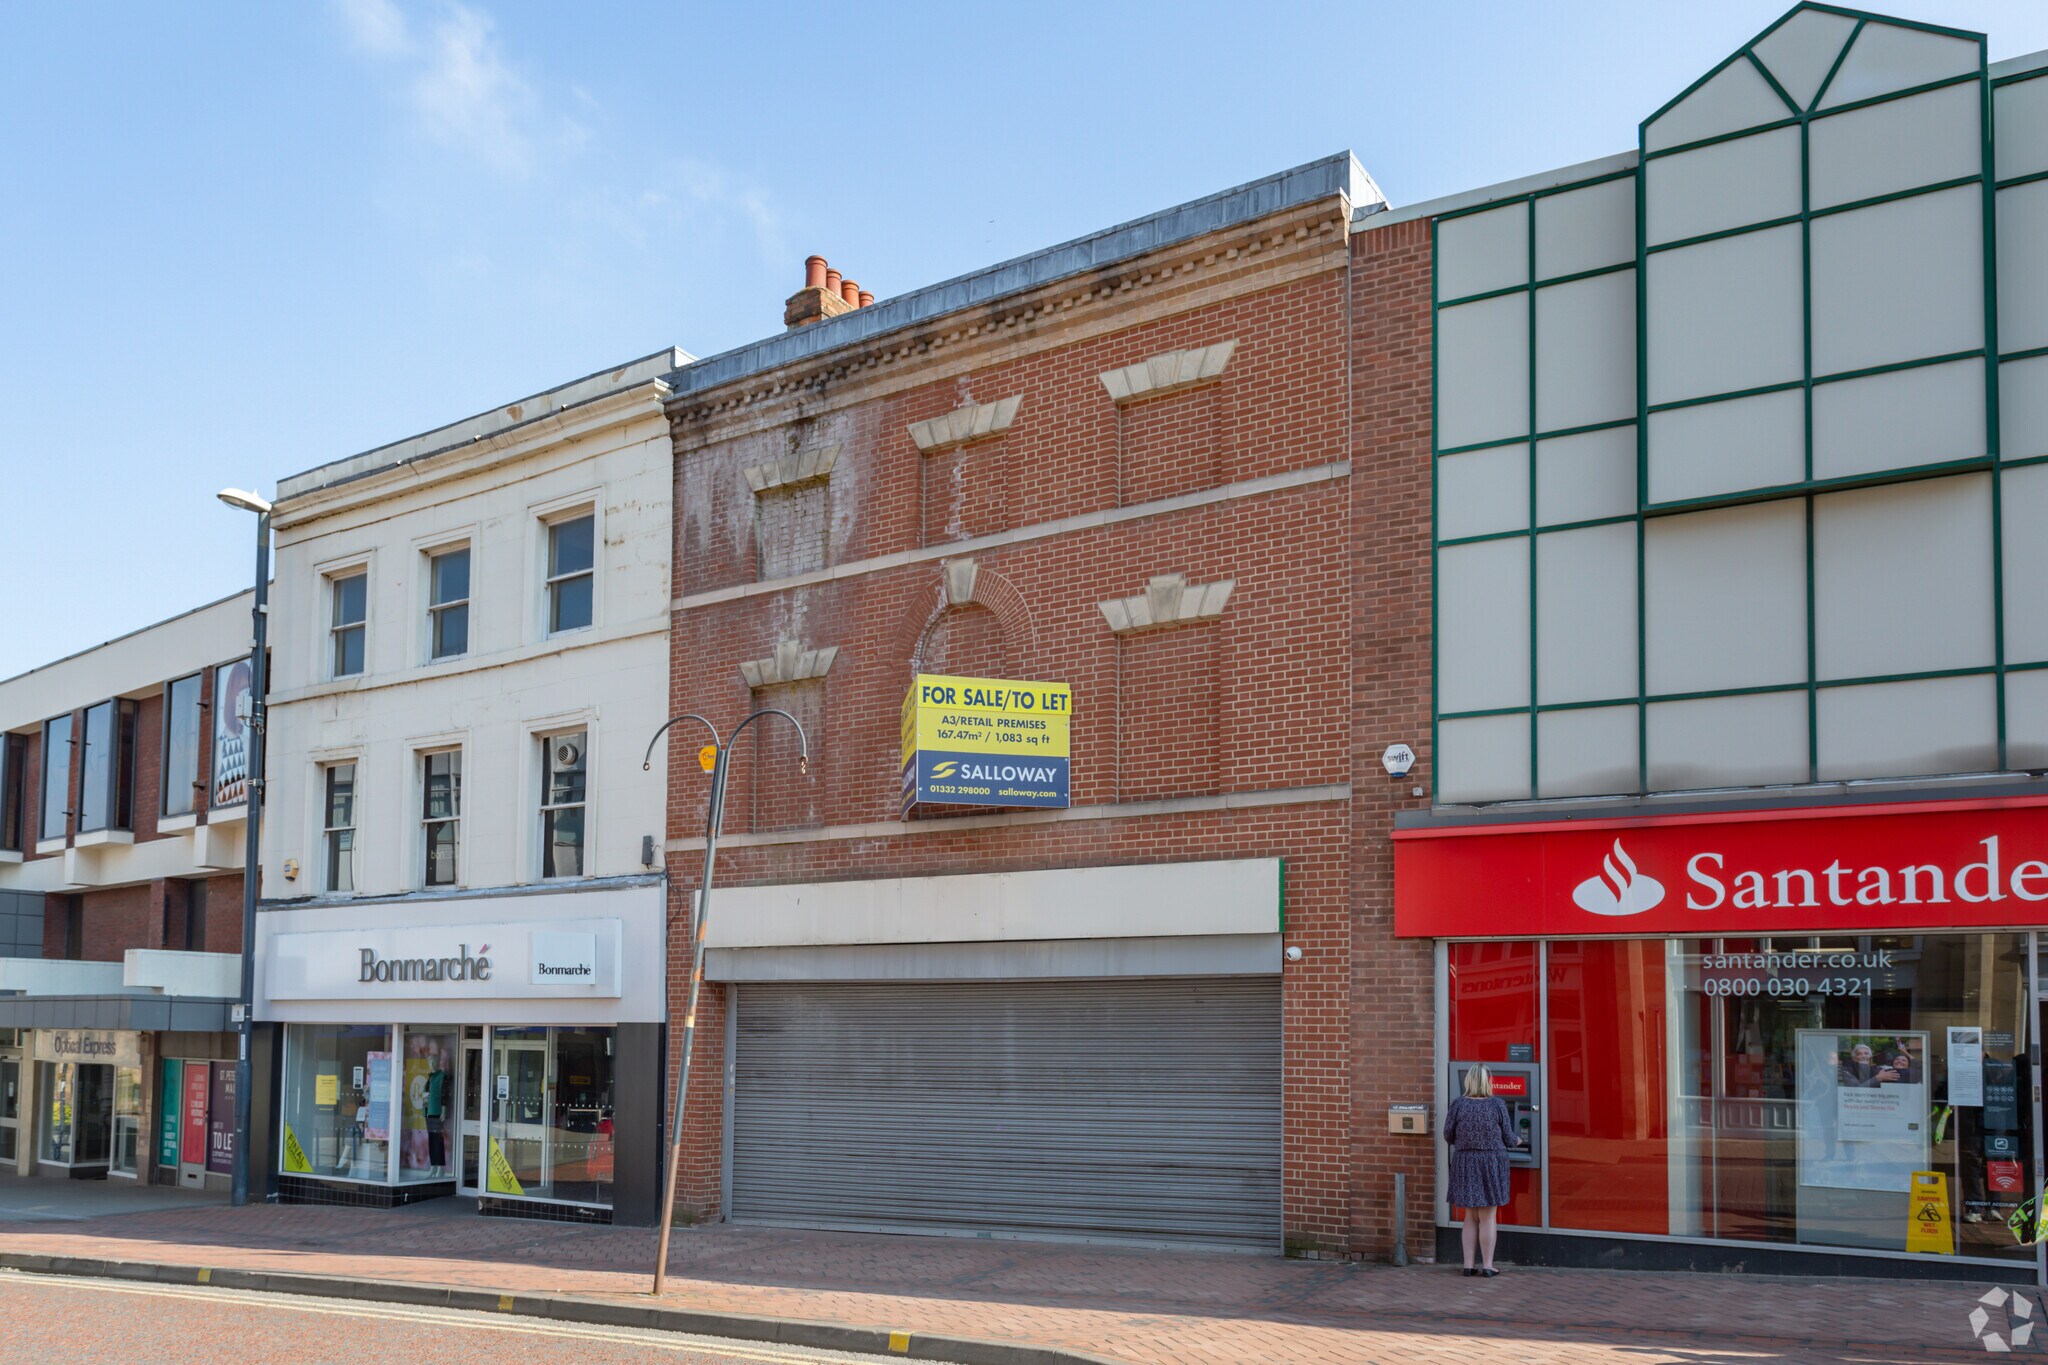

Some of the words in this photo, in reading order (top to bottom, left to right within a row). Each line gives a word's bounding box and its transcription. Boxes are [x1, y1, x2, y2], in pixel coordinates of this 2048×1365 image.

[922, 686, 956, 704] FOR
[964, 688, 1035, 711] SALE/TO
[1042, 693, 1068, 711] LET
[942, 716, 994, 727] A3/RETAIL
[997, 718, 1046, 730] PREMISES
[996, 732, 1022, 744] 1,083
[1026, 736, 1038, 746] sq
[1041, 734, 1050, 744] ft
[1388, 751, 1408, 762] swift
[960, 764, 1057, 782] SALLOWAY
[930, 784, 956, 794] 01332
[958, 786, 990, 795] 298000
[998, 788, 1057, 798] salloway.com
[1686, 834, 2048, 911] Santande
[358, 944, 490, 982] Bonmarché
[1703, 949, 1893, 969] santander.co.uk
[538, 963, 591, 975] Bonmarché
[1704, 978, 1760, 996] 0800
[1768, 978, 1809, 996] 030
[1817, 978, 1872, 996] 4321
[54, 1036, 81, 1057] Optical
[84, 1037, 116, 1058] Express
[1491, 1081, 1522, 1091] ntander
[212, 1132, 222, 1150] TO
[286, 1133, 305, 1164] FINAL
[493, 1148, 514, 1182] FINAL
